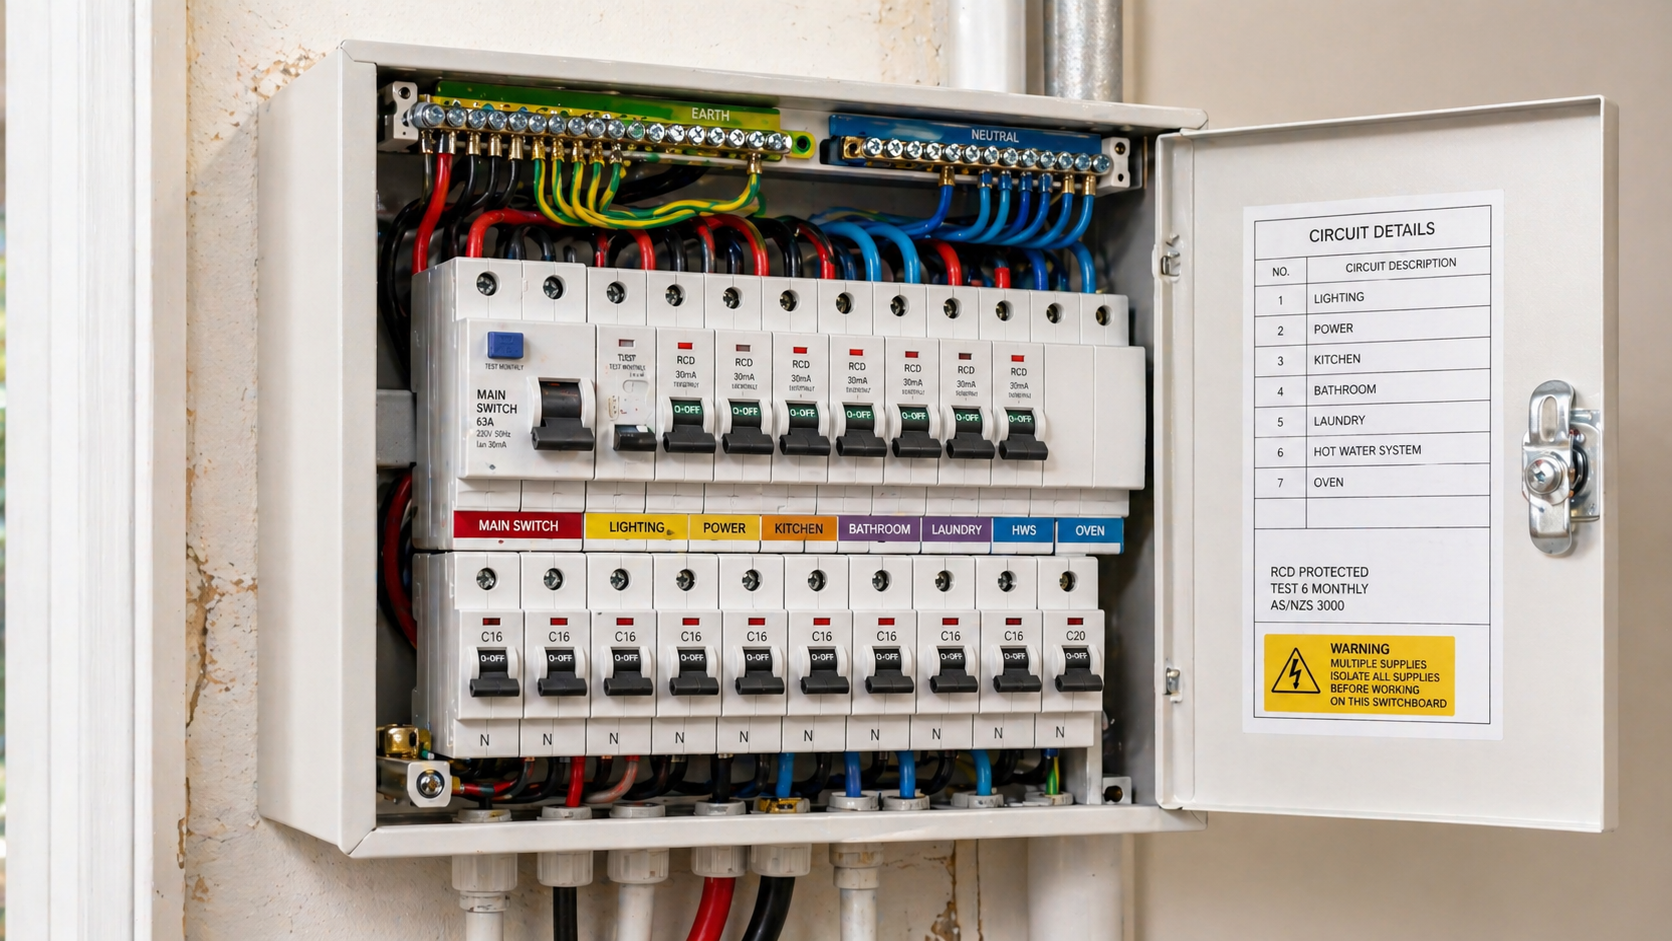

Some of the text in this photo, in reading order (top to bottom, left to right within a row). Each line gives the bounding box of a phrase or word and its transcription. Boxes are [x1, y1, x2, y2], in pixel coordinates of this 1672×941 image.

[691, 108, 730, 121] EARTH
[971, 129, 1019, 142] NEUTRAL
[1309, 222, 1435, 243] CIRCUIT DETAILS
[1345, 257, 1457, 273] CIRCUIT DESCRIPTION
[1272, 267, 1289, 277] NO.
[1279, 295, 1283, 305] 1
[1314, 292, 1365, 304] LIGHTING
[1277, 326, 1284, 336] 2
[1314, 323, 1354, 334] POWER
[677, 356, 695, 365] RCD
[735, 358, 753, 367] RCD
[792, 360, 810, 369] RCD
[1277, 356, 1284, 366] 3
[1314, 354, 1361, 365] KITCHEN
[849, 362, 866, 371] RCD
[904, 364, 921, 372] RCD
[958, 366, 975, 374] RCD
[1011, 368, 1027, 376] RCD
[676, 371, 697, 379] 30mA
[734, 373, 755, 381] 30mA
[847, 376, 868, 384] 30mA
[903, 378, 923, 386] 30mA
[957, 380, 976, 388] 30mA
[1010, 382, 1029, 390] 30mA
[477, 389, 505, 400] MAIN
[1277, 387, 1284, 396] 4
[1314, 384, 1377, 395] BATHROOM
[476, 403, 517, 414] SWITCH
[476, 417, 494, 426] 63A
[1277, 417, 1284, 427] 5
[1314, 415, 1365, 426] LAUNDRY
[1277, 448, 1284, 457] 6
[1314, 445, 1422, 457] HOT WATER SYSTEM
[1277, 478, 1284, 488] 7
[1314, 478, 1344, 488] OVEN
[479, 520, 559, 532] MAIN SWITCH
[609, 521, 665, 533] LIGHTING
[703, 522, 746, 534] POWER
[775, 523, 823, 535] KITCHEN
[849, 523, 911, 535] BATHROOM
[931, 524, 982, 536] LAUNDRY
[1012, 525, 1036, 536] HWS
[1075, 525, 1105, 536] OVEN
[1270, 567, 1369, 578] RCD PROTECTED
[1270, 583, 1369, 594] TEST 6 MONTHLY
[1270, 600, 1345, 611] AS/NZS 3000
[481, 632, 502, 642] C16
[548, 632, 570, 642] C16
[615, 631, 636, 642] C16
[681, 631, 702, 642] C16
[747, 631, 767, 642] C16
[812, 631, 832, 641] C16
[876, 631, 897, 642] C16
[941, 631, 961, 641] C16
[1004, 631, 1024, 641] C16
[1066, 631, 1086, 641] C20
[1330, 643, 1390, 654] WARNING
[1330, 659, 1427, 669] MULTIPLE SUPPLIES
[1330, 672, 1440, 682] ISOLATE ALL SUPPLIES
[1330, 684, 1420, 694] BEFORE WORKING
[1330, 697, 1447, 708] ON THIS SWITCHBOARD
[675, 732, 684, 743] N
[739, 731, 748, 742] N
[804, 730, 813, 741] N
[871, 729, 880, 740] N
[932, 728, 941, 739] N
[994, 727, 1003, 738] N
[1056, 727, 1064, 738] N
[480, 734, 490, 746] N
[543, 733, 552, 745] N
[610, 733, 618, 744] N
